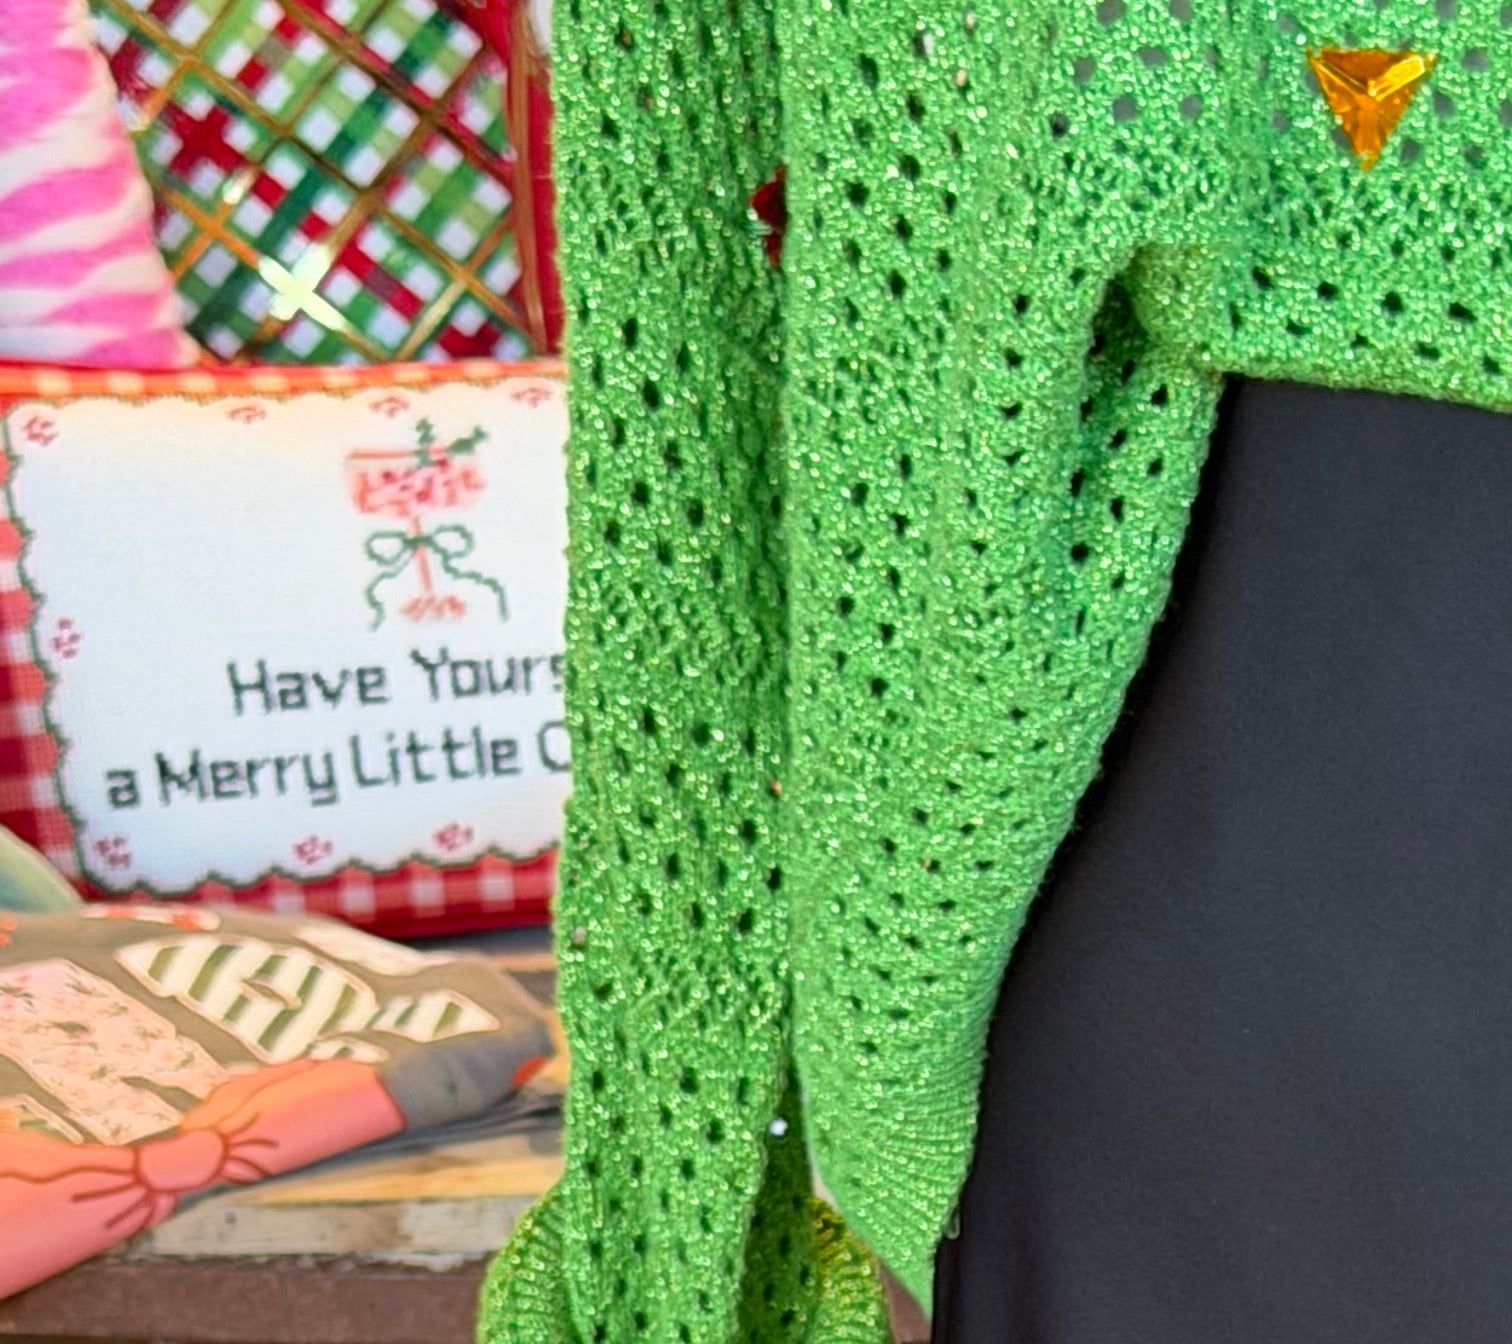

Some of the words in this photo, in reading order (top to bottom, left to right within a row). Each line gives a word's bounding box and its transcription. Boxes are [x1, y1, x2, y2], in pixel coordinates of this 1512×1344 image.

[229, 658, 389, 717] Have
[106, 768, 141, 809] a
[154, 749, 338, 808] Merry
[350, 726, 522, 788] Little
